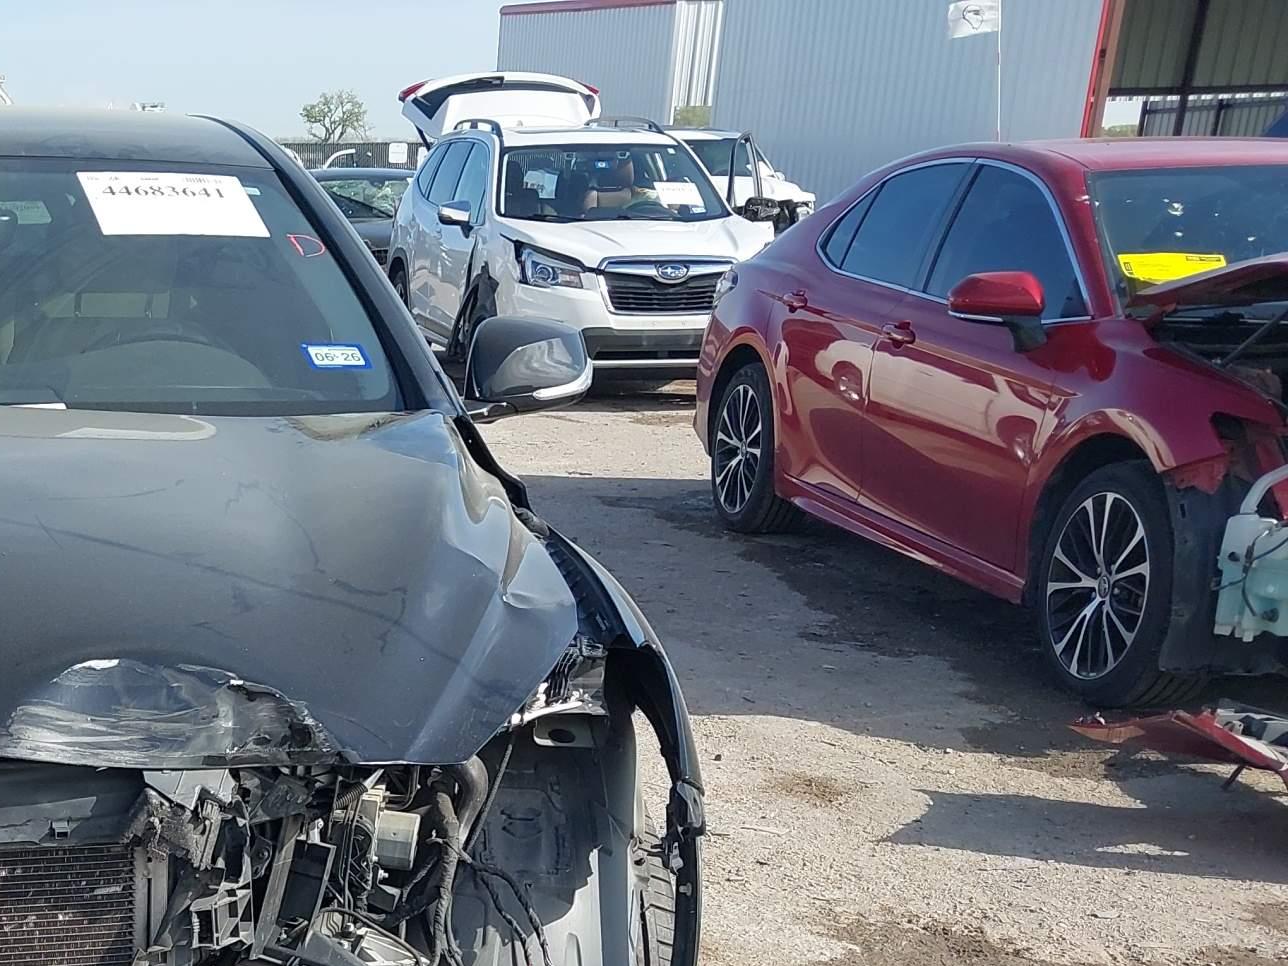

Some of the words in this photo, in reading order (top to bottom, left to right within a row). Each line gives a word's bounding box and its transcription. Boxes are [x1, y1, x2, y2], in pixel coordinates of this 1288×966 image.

[102, 185, 225, 199] 44683641
[286, 234, 326, 257] D
[314, 352, 335, 362] 06
[341, 352, 361, 362] 26
